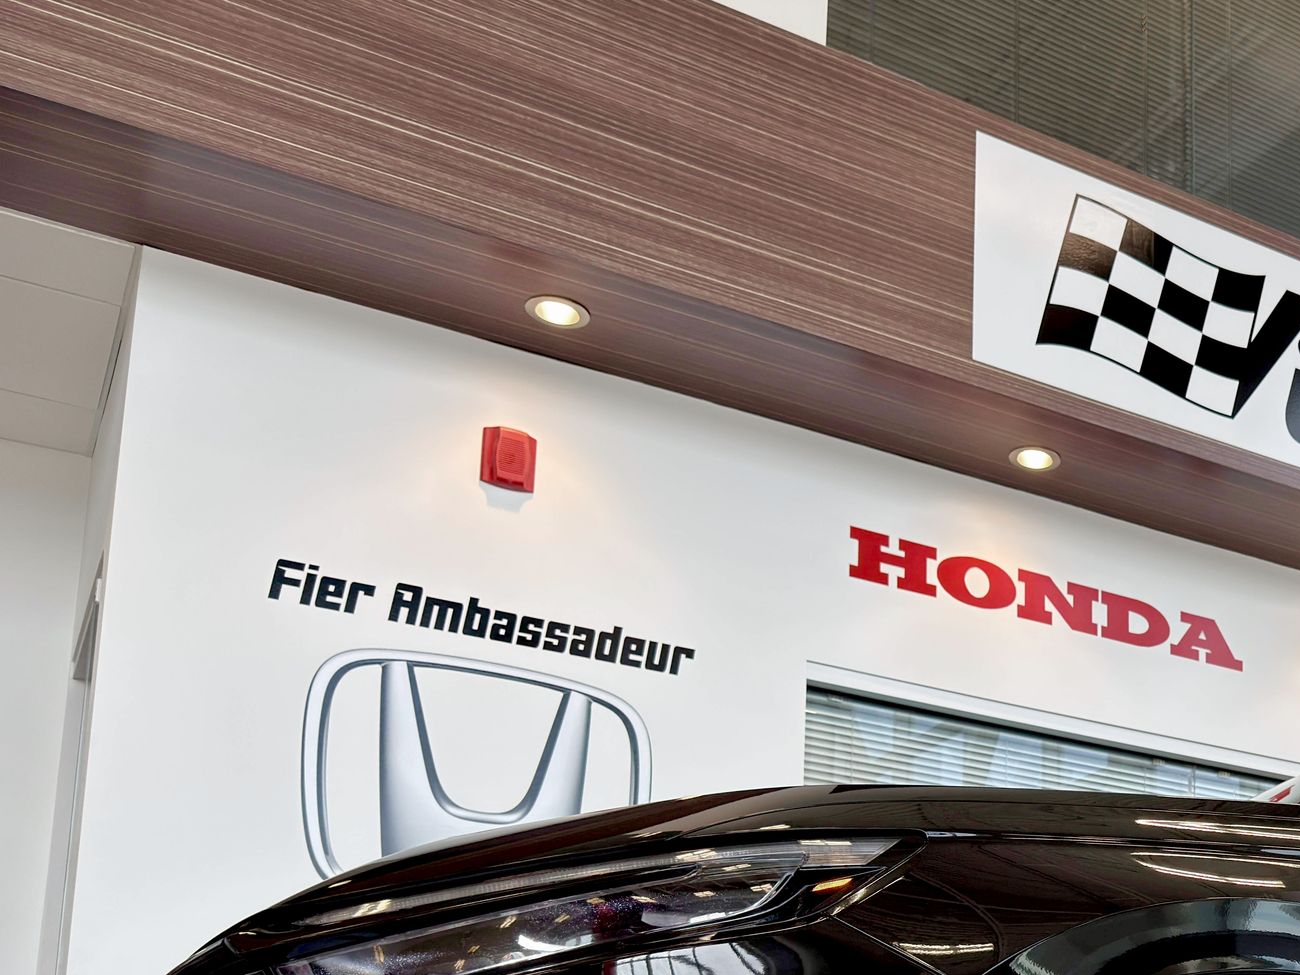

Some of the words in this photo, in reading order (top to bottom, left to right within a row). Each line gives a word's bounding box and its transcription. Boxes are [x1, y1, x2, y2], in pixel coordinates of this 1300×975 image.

[267, 558, 376, 615] Fier
[387, 581, 696, 676] Ambassadeur
[849, 525, 1244, 672] HONDA
